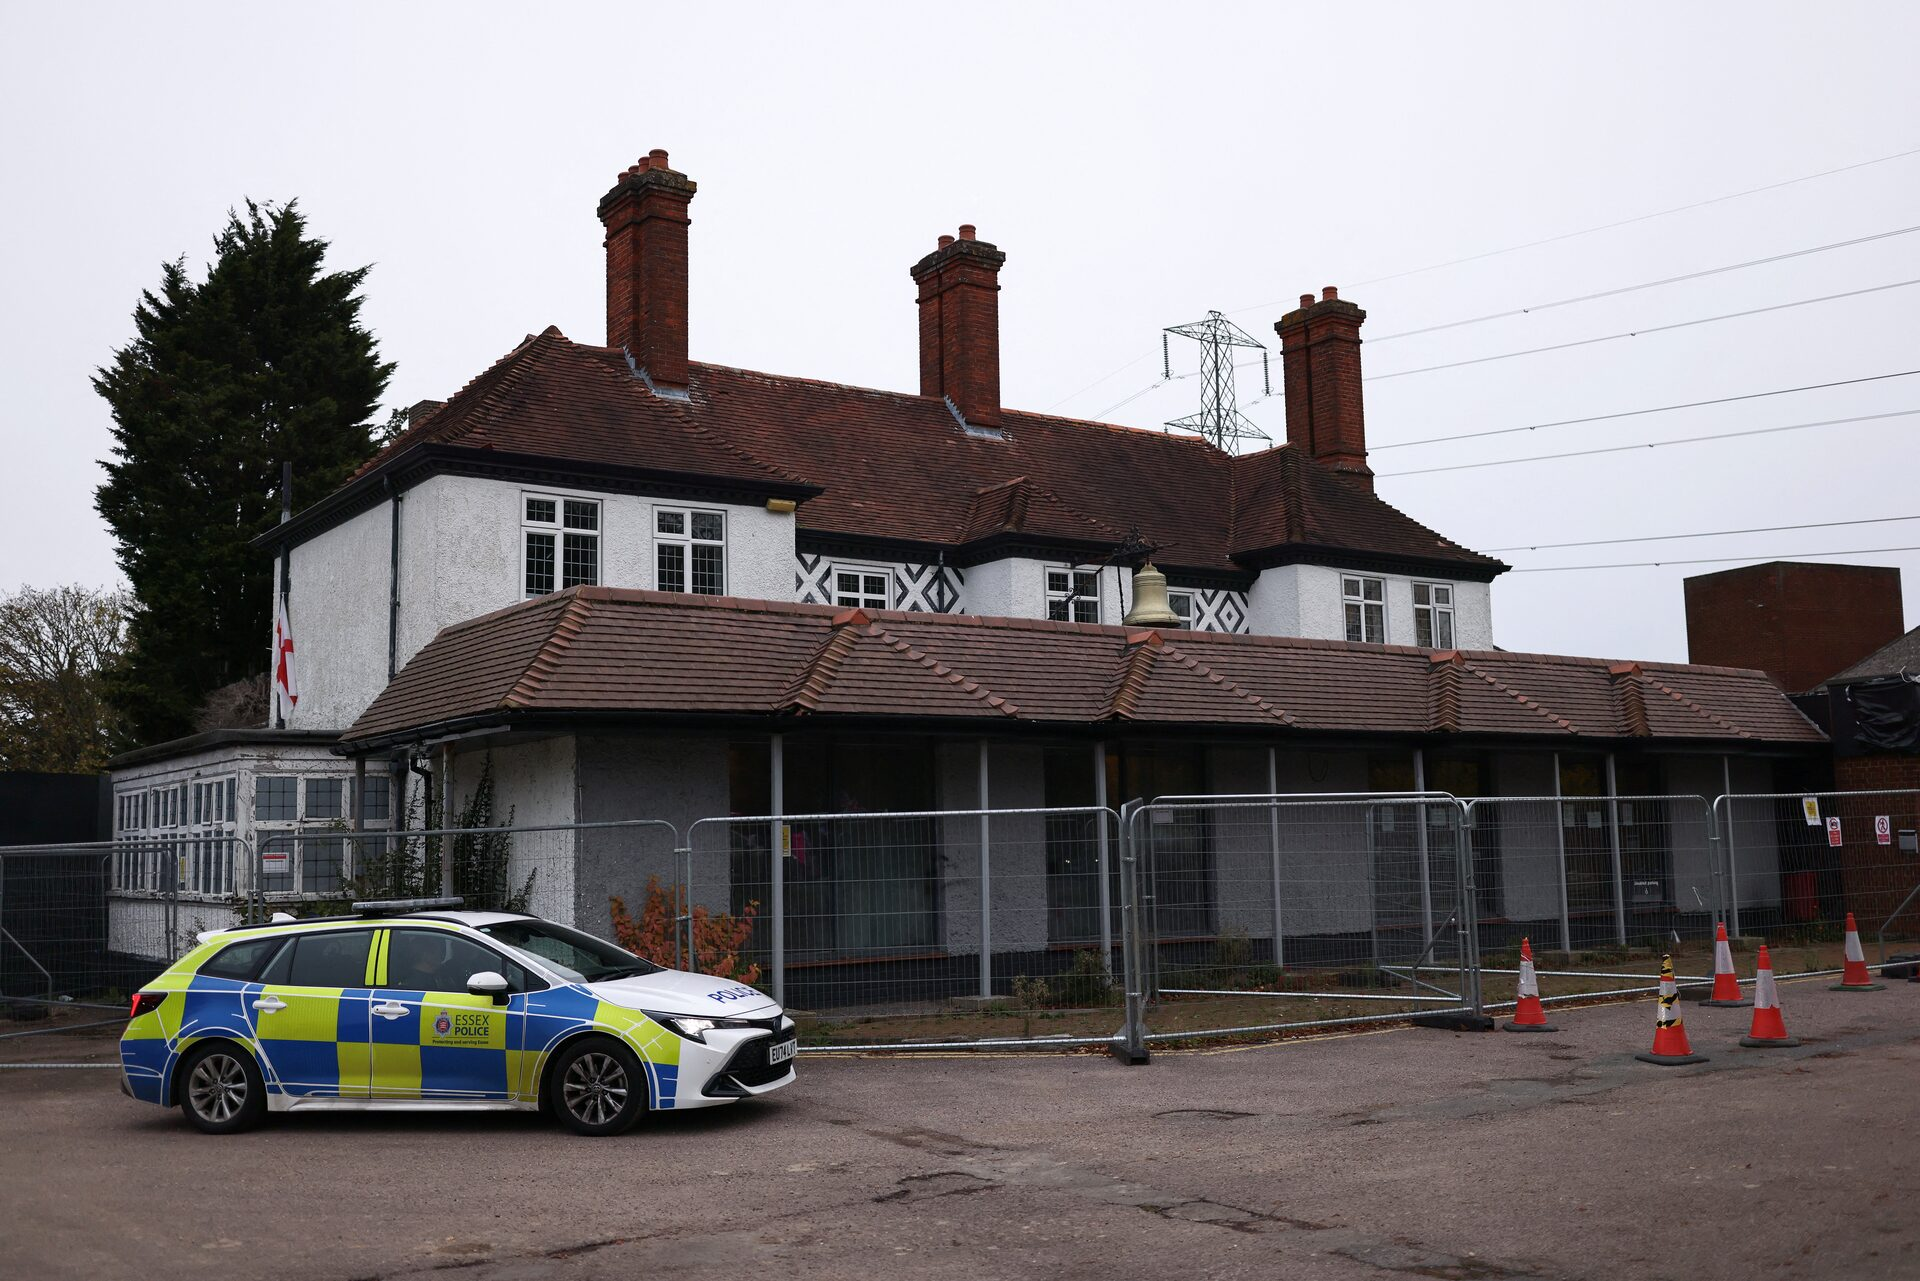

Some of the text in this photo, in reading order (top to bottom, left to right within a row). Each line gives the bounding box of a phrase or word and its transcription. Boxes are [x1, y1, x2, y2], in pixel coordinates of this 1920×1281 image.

[707, 987, 761, 1003] POLICE
[456, 1015, 489, 1025] ESSEX
[455, 1026, 489, 1036] POLICE
[772, 1045, 786, 1061] EU74
